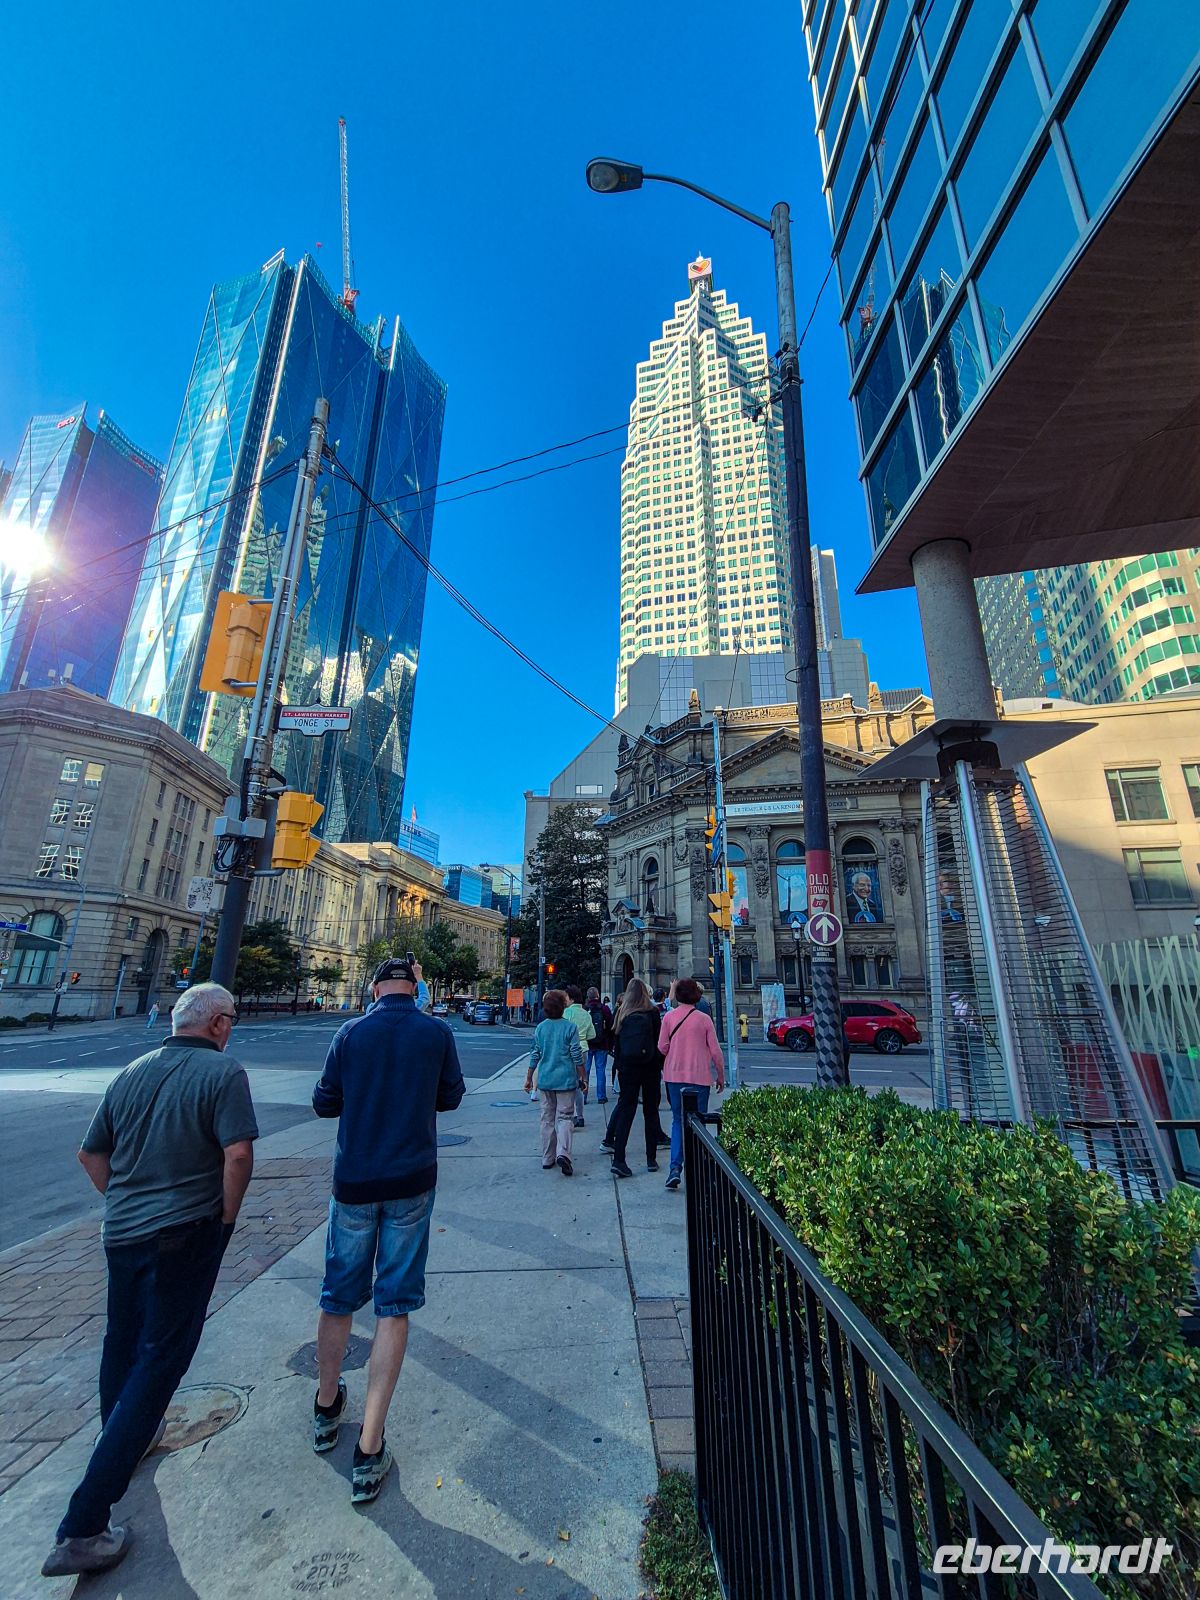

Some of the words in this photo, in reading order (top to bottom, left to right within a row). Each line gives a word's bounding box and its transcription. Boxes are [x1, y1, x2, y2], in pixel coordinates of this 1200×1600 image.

[294, 718, 319, 727] YONGE
[324, 719, 335, 728] ST.
[809, 873, 829, 885] OLD
[809, 885, 830, 895] TOWN
[307, 1562, 350, 1580] 2013
